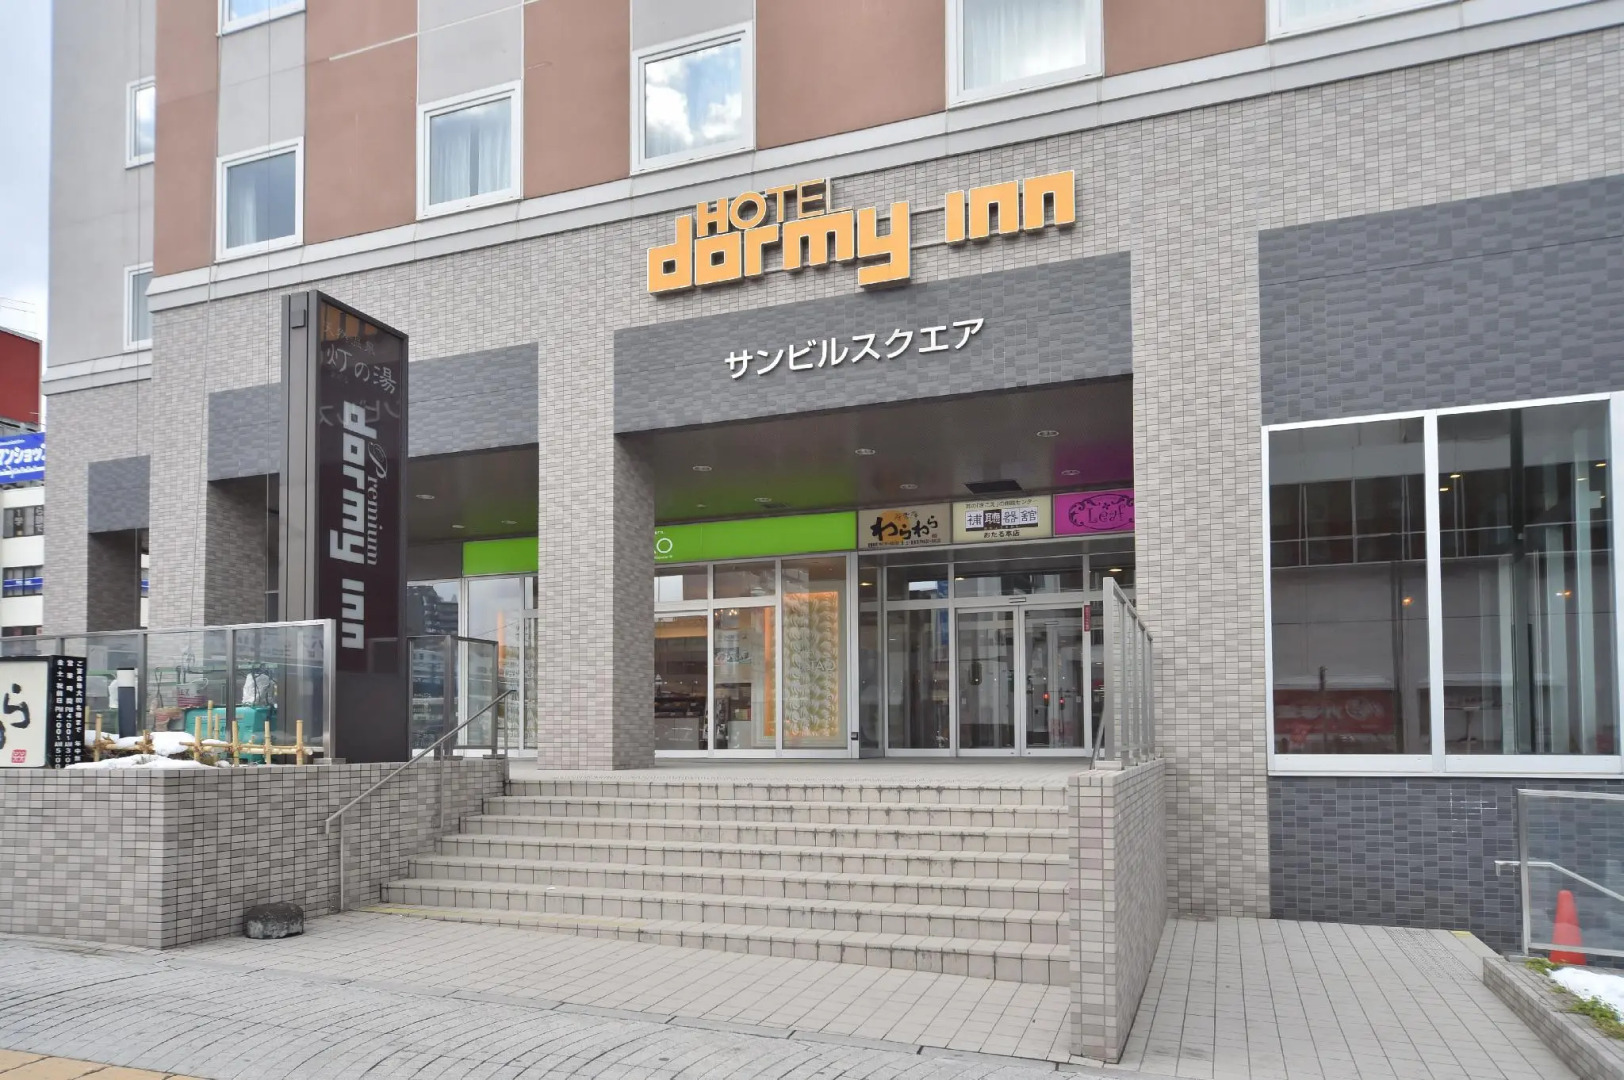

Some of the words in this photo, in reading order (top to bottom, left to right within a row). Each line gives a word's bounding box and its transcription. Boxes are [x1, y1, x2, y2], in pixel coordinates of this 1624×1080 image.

[646, 200, 911, 294] dormy
[945, 169, 1076, 243] inn
[696, 177, 851, 238] HOTEL
[327, 334, 397, 394] 灯の湯
[724, 318, 985, 379] サンビルスクエア
[330, 400, 377, 565] dormy
[367, 442, 388, 566] Premium
[870, 515, 938, 541] わらわら
[341, 579, 364, 650] inn
